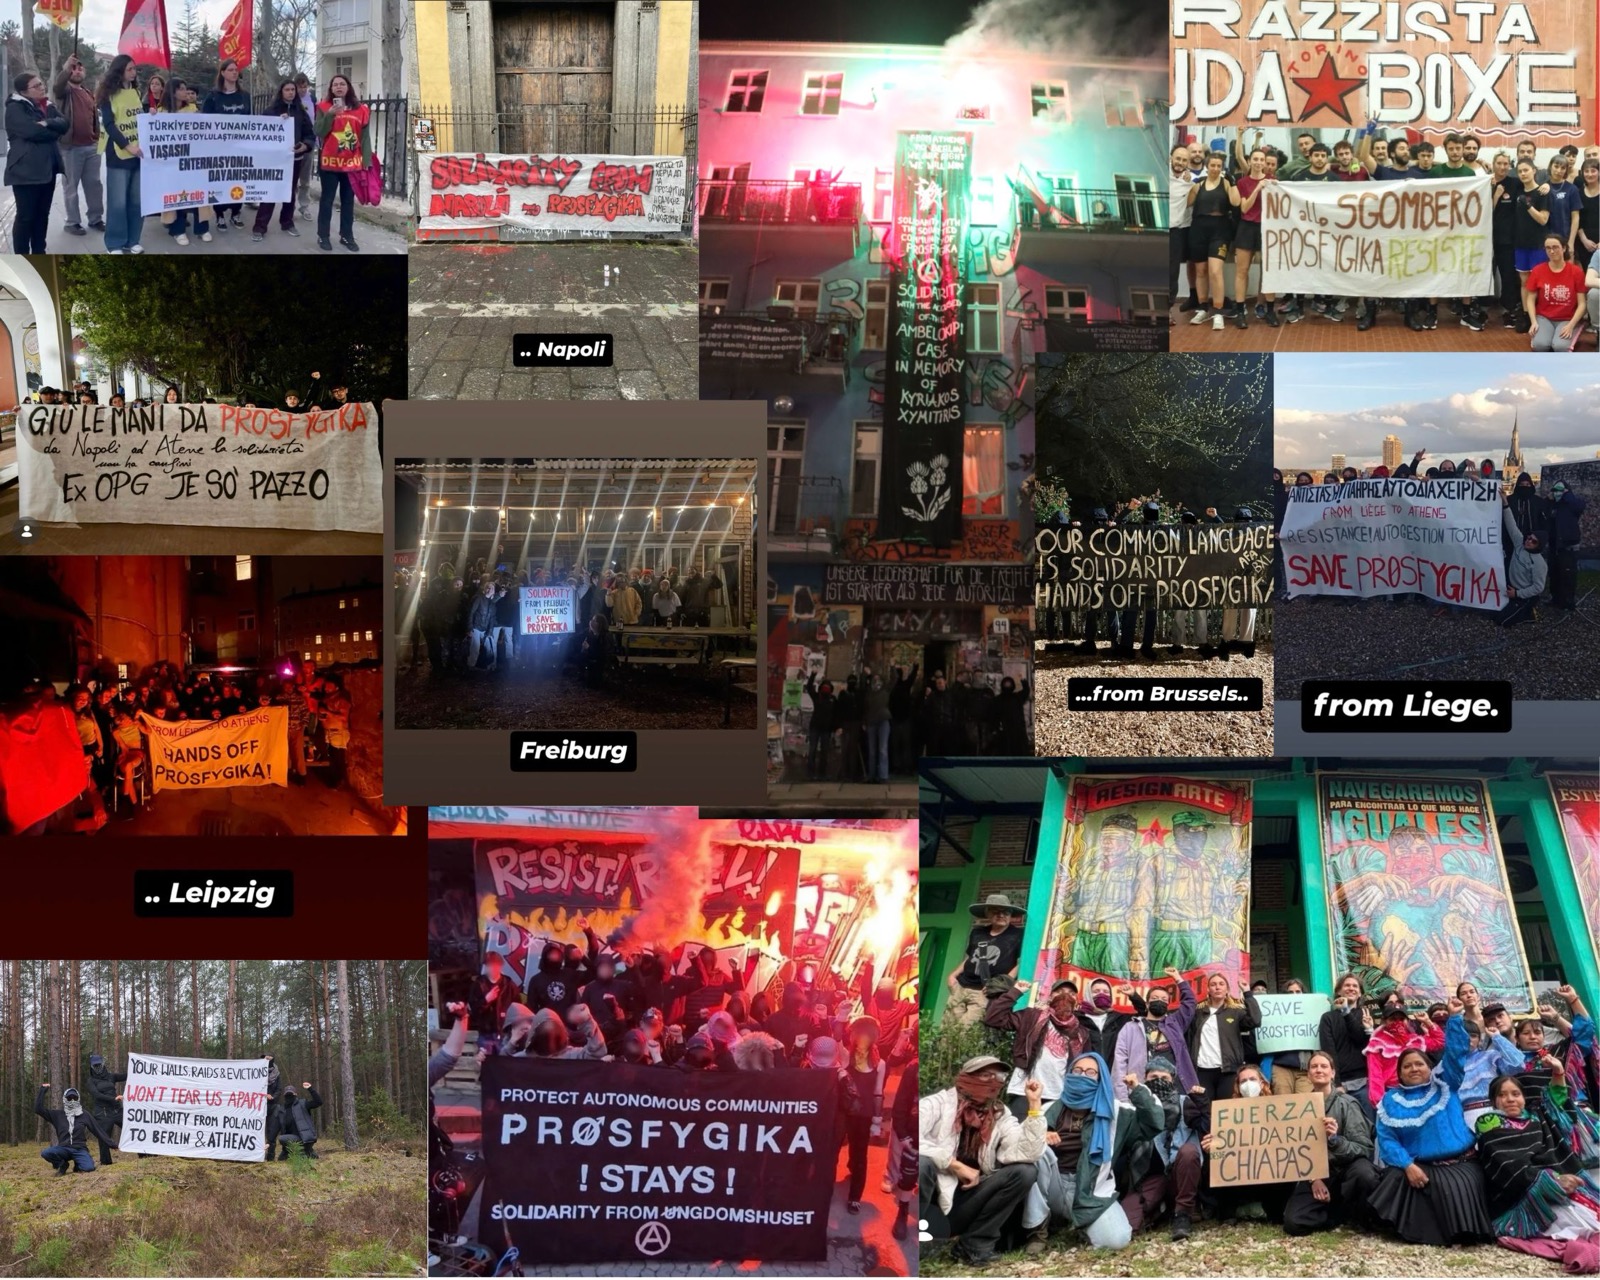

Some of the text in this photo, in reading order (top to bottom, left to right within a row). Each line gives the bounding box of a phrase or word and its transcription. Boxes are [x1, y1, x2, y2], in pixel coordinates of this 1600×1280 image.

[1287, 43, 1368, 76] TORINO
[1367, 51, 1581, 127] BOXE
[149, 134, 176, 142] RANTA
[149, 143, 191, 160] YAŞASIN
[179, 156, 254, 171] ENTERNASYONAL
[163, 194, 178, 204] DEV
[1265, 190, 1292, 220] NO
[1337, 189, 1483, 231] SGOMBERO
[1264, 228, 1487, 278] PROSFYGIKA RESISTE
[897, 283, 964, 300] SOLIDARITY
[896, 301, 915, 310] WITH
[916, 302, 931, 310] THE
[918, 313, 929, 321] OF
[916, 342, 948, 359] CASE
[895, 358, 965, 378] IN MEMORY
[921, 379, 938, 391] OF
[900, 388, 960, 408] KYRIAKOS
[81, 404, 105, 434] LE
[111, 404, 164, 436] MANI
[179, 405, 208, 434] DA
[43, 437, 61, 455] da
[72, 431, 121, 462] Napoli
[131, 439, 148, 455] ad
[155, 433, 205, 456] Atene
[211, 436, 227, 453] la
[125, 455, 137, 468] ha
[63, 473, 87, 503] Ex
[95, 470, 152, 502] OPG
[165, 470, 200, 500] JE
[249, 468, 330, 501] PAZZO
[1322, 504, 1353, 520] FROM
[1392, 505, 1402, 515] TO
[1408, 505, 1447, 519] ATHENS
[1034, 527, 1084, 555] OUR
[1089, 528, 1181, 556] COMMON
[1188, 525, 1274, 556] LANGUAGE
[1373, 523, 1445, 545] AUTOGESTION
[1449, 526, 1498, 545] TOTALE
[827, 565, 869, 583] UNSERE
[970, 567, 985, 585] DIE
[1038, 554, 1188, 582] IS SOLIDARITY
[1288, 553, 1352, 590] SAVE
[527, 588, 570, 599] SOLIDARITY
[826, 583, 844, 600] IST
[896, 582, 917, 601] ALS
[1034, 580, 1104, 610] HANDS
[1110, 581, 1149, 608] OFF
[525, 600, 542, 608] FROM
[543, 607, 568, 615] ATHENS
[536, 615, 555, 623] SAVE
[150, 724, 177, 738] FROM
[215, 718, 229, 729] TO
[231, 714, 270, 728] ATHENS
[164, 739, 260, 764] HANDS OFF
[155, 762, 272, 785] PROSFYGIKA!
[1329, 780, 1478, 803] NAVEGAREMOS
[1329, 801, 1481, 814] PARA ENCONTRAR LO QUE NOS HACE
[1329, 809, 1486, 847] IGUALES
[1261, 1001, 1304, 1017] SAVE
[131, 1058, 158, 1076] YOUR
[191, 1066, 218, 1079] RAIDS
[220, 1067, 226, 1079] &
[227, 1066, 268, 1080] EVICTIONS
[127, 1084, 268, 1111] WON'T TEAR US APART
[501, 1088, 818, 1115] PROTECT AUTONOMOUS COMMUNITIES
[127, 1108, 263, 1131] SOLIDARITY FROM POLAND
[1218, 1100, 1318, 1127] FUERZA
[129, 1128, 257, 1150] TO BERLIN & ATHENS
[1216, 1125, 1319, 1151] SOLIDARIA
[1219, 1144, 1314, 1183] CHIAPAS
[579, 1163, 736, 1196] ! STAYS !
[490, 1204, 815, 1226] SOLIDARITY FROM UNGDOMSHUSET
